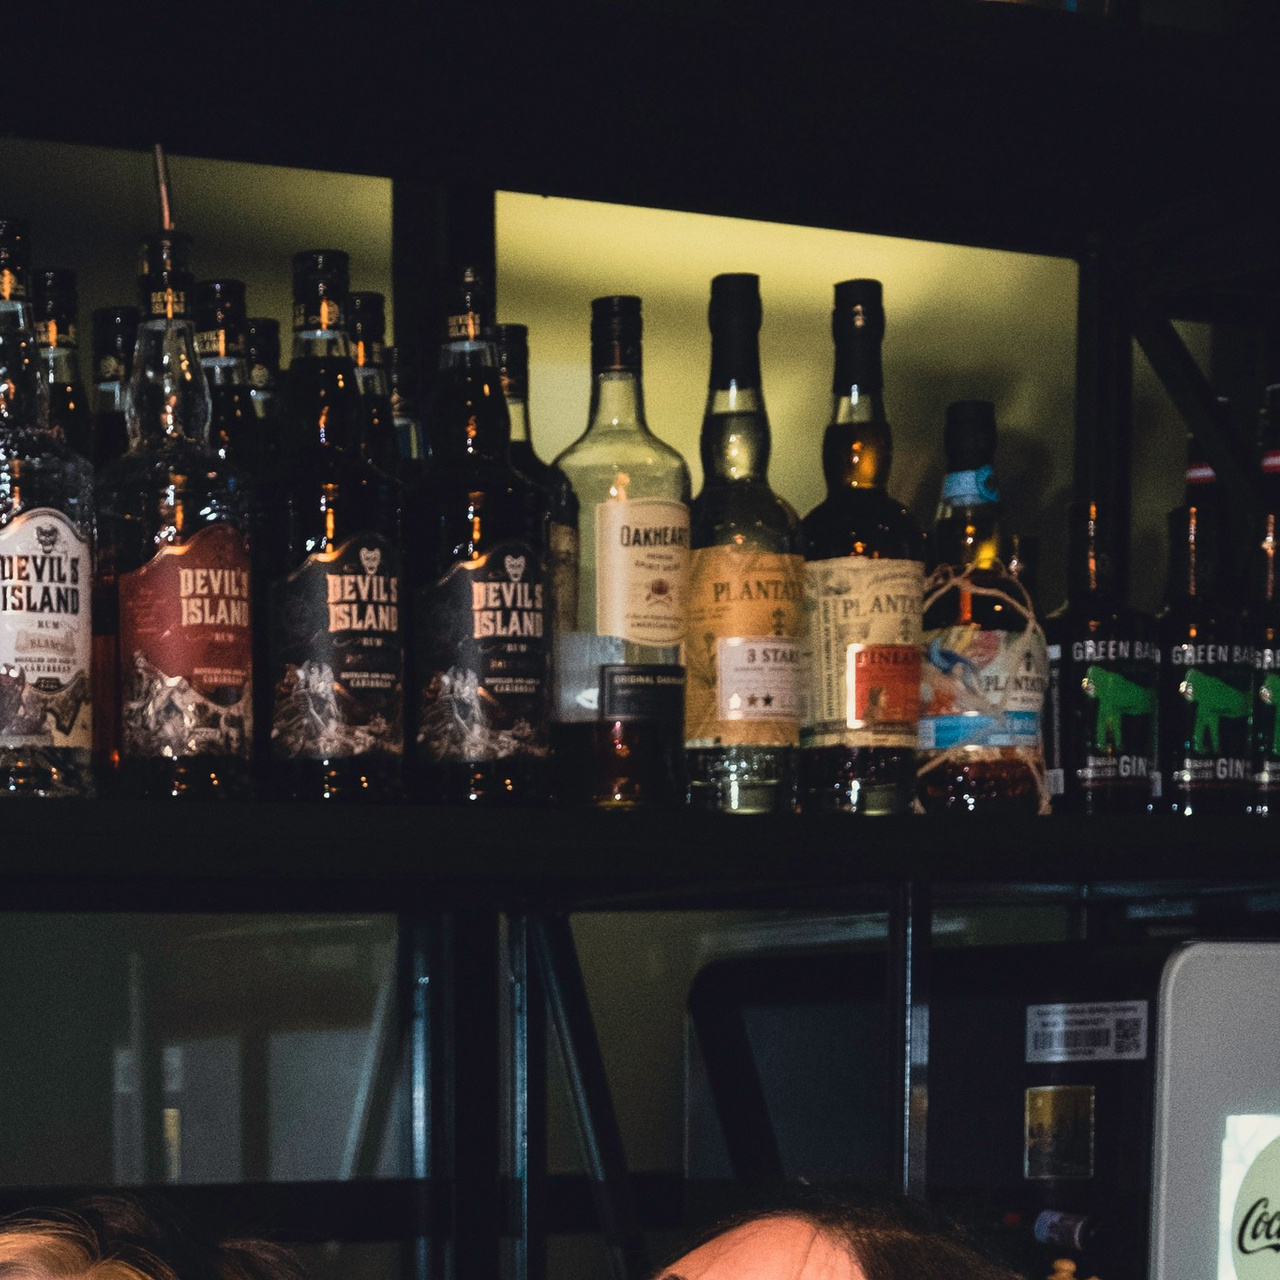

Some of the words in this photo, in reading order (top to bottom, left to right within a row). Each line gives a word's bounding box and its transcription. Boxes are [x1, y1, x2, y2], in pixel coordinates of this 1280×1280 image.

[2, 585, 79, 614] ISLAND
[328, 603, 398, 633] ISLAND
[473, 610, 543, 639] ISLAND
[747, 649, 756, 663] 3
[1073, 640, 1130, 661] GREEN
[1172, 644, 1229, 665] GREEN
[1119, 755, 1148, 777] GIN
[1216, 758, 1245, 780] GIN
